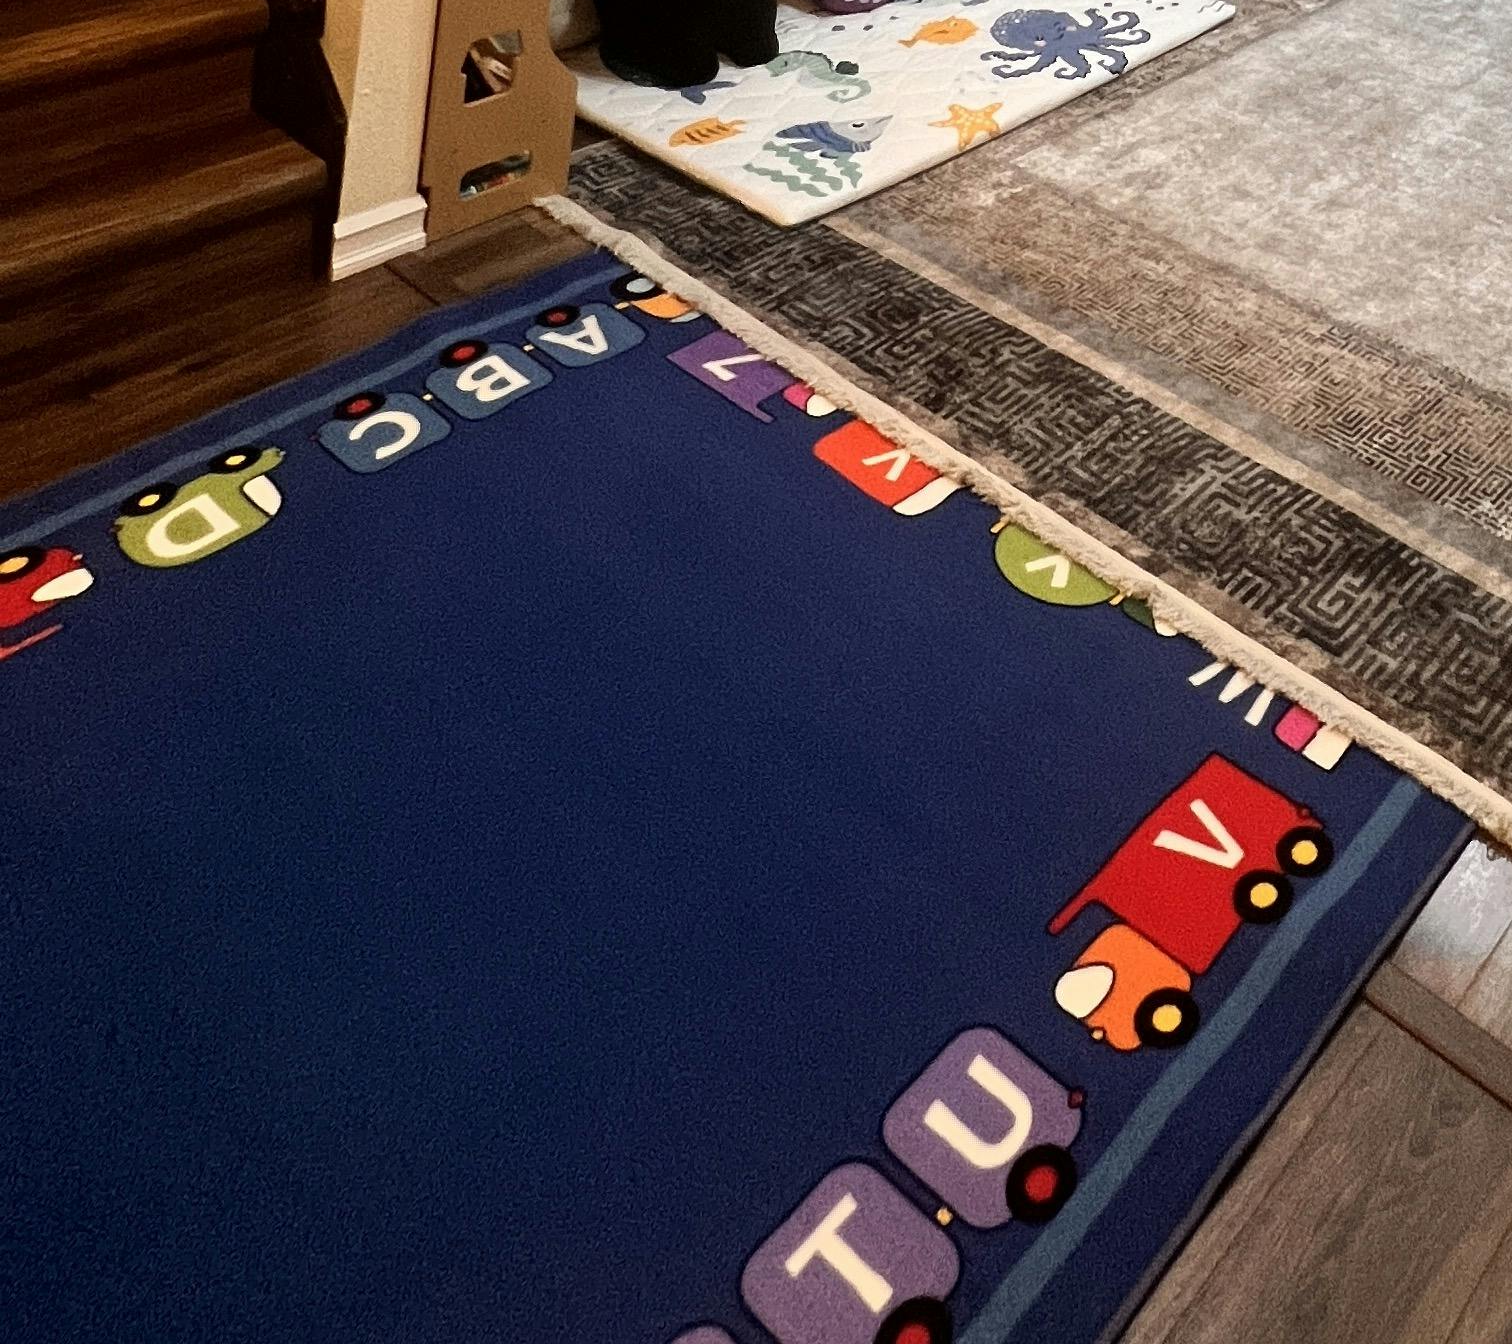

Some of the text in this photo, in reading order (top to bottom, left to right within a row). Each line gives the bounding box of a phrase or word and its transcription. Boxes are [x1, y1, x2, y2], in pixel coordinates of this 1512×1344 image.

[145, 315, 608, 558] A B C D
[785, 1193, 893, 1314] T
[922, 1054, 1033, 1169] U
[1152, 798, 1245, 870] V
